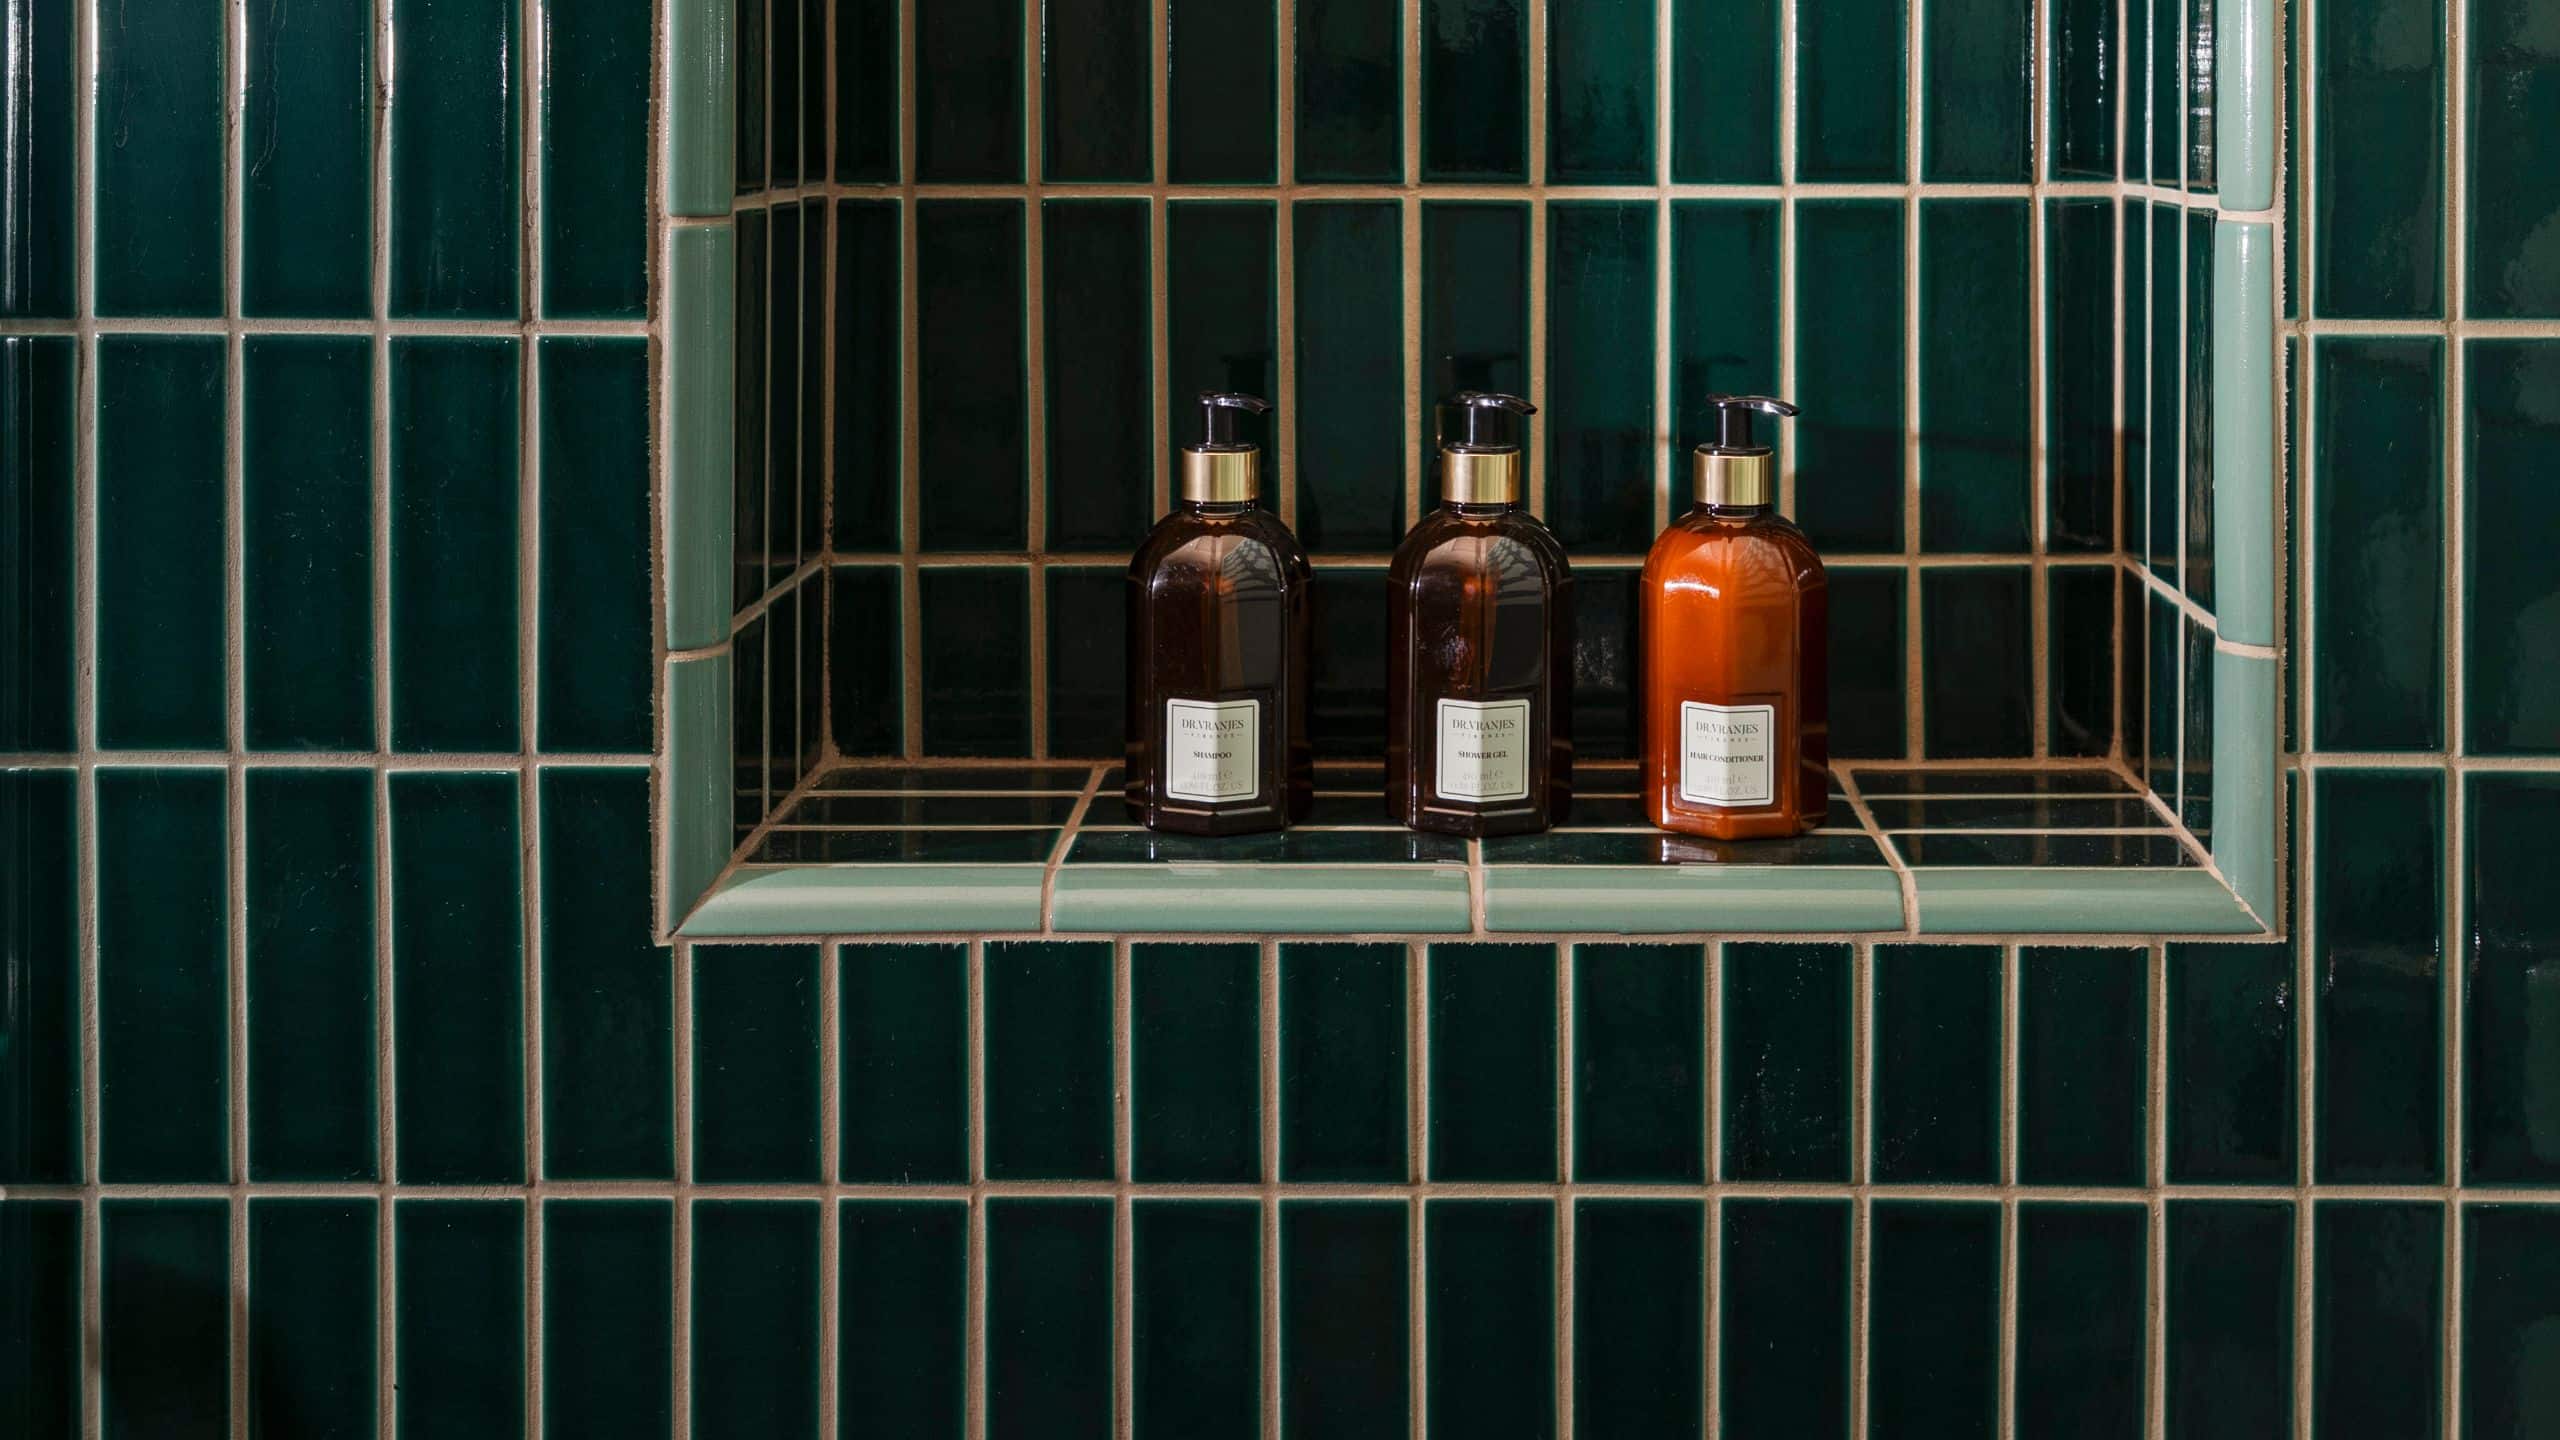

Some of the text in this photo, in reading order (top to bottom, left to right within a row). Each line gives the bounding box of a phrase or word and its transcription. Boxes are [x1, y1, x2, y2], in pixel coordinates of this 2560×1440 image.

[1193, 751, 1232, 760] SHAMPOO
[1458, 751, 1508, 760] SHOWER GEL
[1689, 751, 1764, 763] HAIR CONDITIONER
